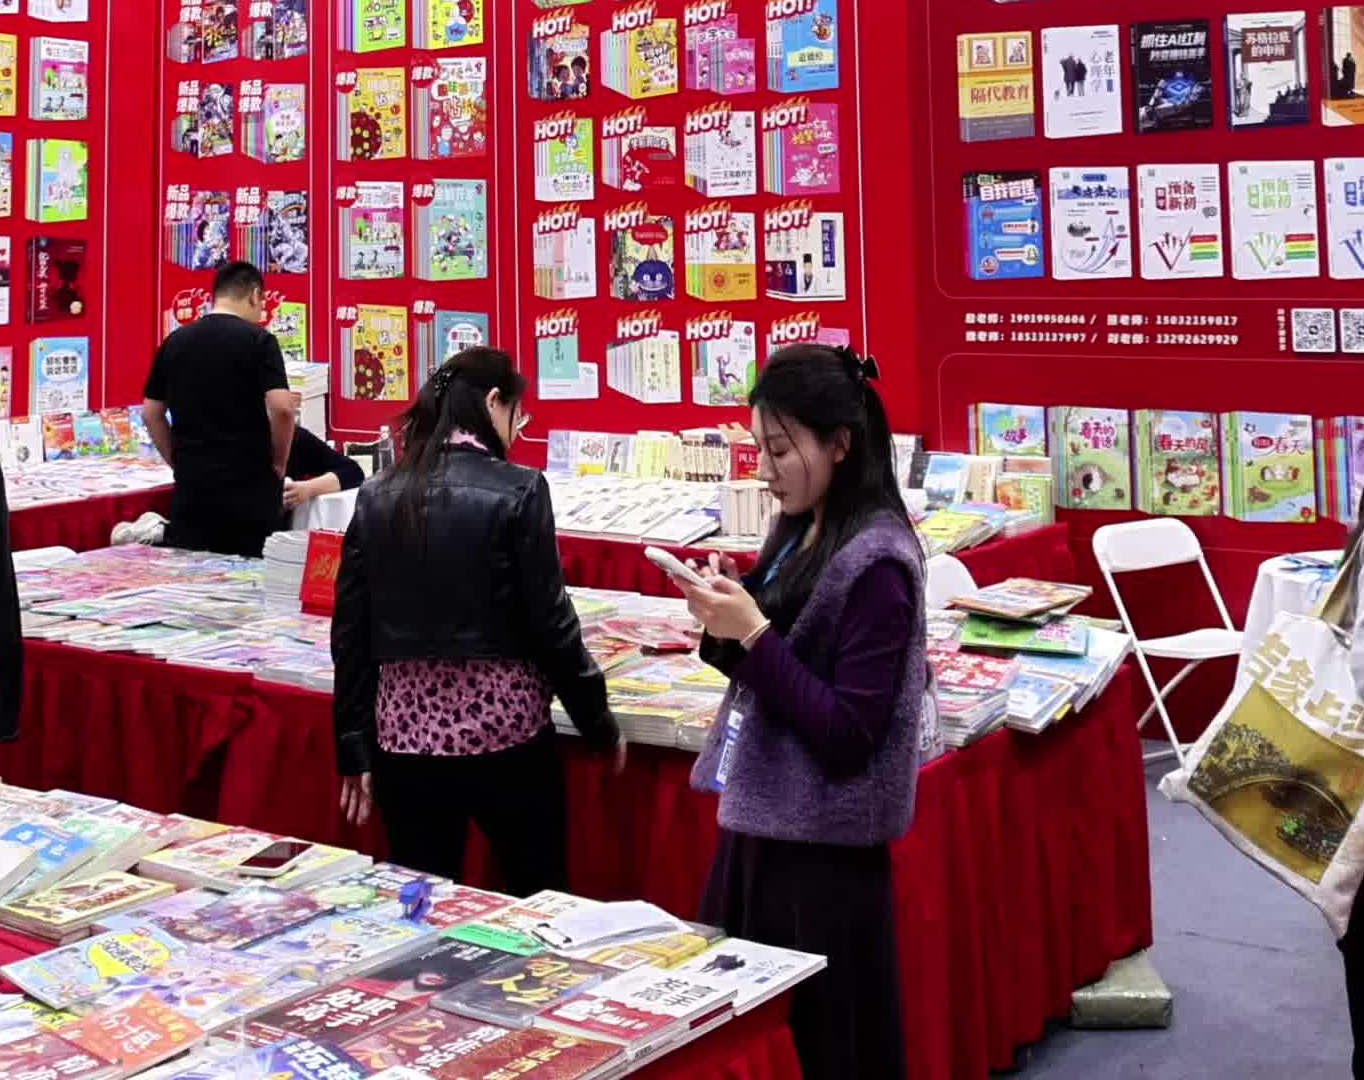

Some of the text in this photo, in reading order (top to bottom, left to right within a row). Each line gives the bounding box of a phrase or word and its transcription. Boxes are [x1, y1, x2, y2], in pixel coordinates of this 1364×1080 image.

[612, 8, 654, 32] HOT!
[685, 1, 728, 27] HOT!
[533, 15, 572, 39] HOT!
[534, 118, 573, 142] HOT!
[602, 113, 644, 138] HOT!
[685, 110, 729, 135] HOT!
[762, 106, 808, 130] HOT!
[979, 178, 1036, 201] 自我管理
[537, 212, 577, 234] HOT!
[603, 211, 645, 233] HOT!
[685, 209, 730, 233] HOT!
[763, 208, 812, 232] HOT!
[535, 317, 577, 337] HOT!
[617, 318, 661, 339] HOT!
[686, 319, 731, 341] HOT!
[771, 320, 819, 344] HOT!
[1273, 435, 1305, 456] 春天
